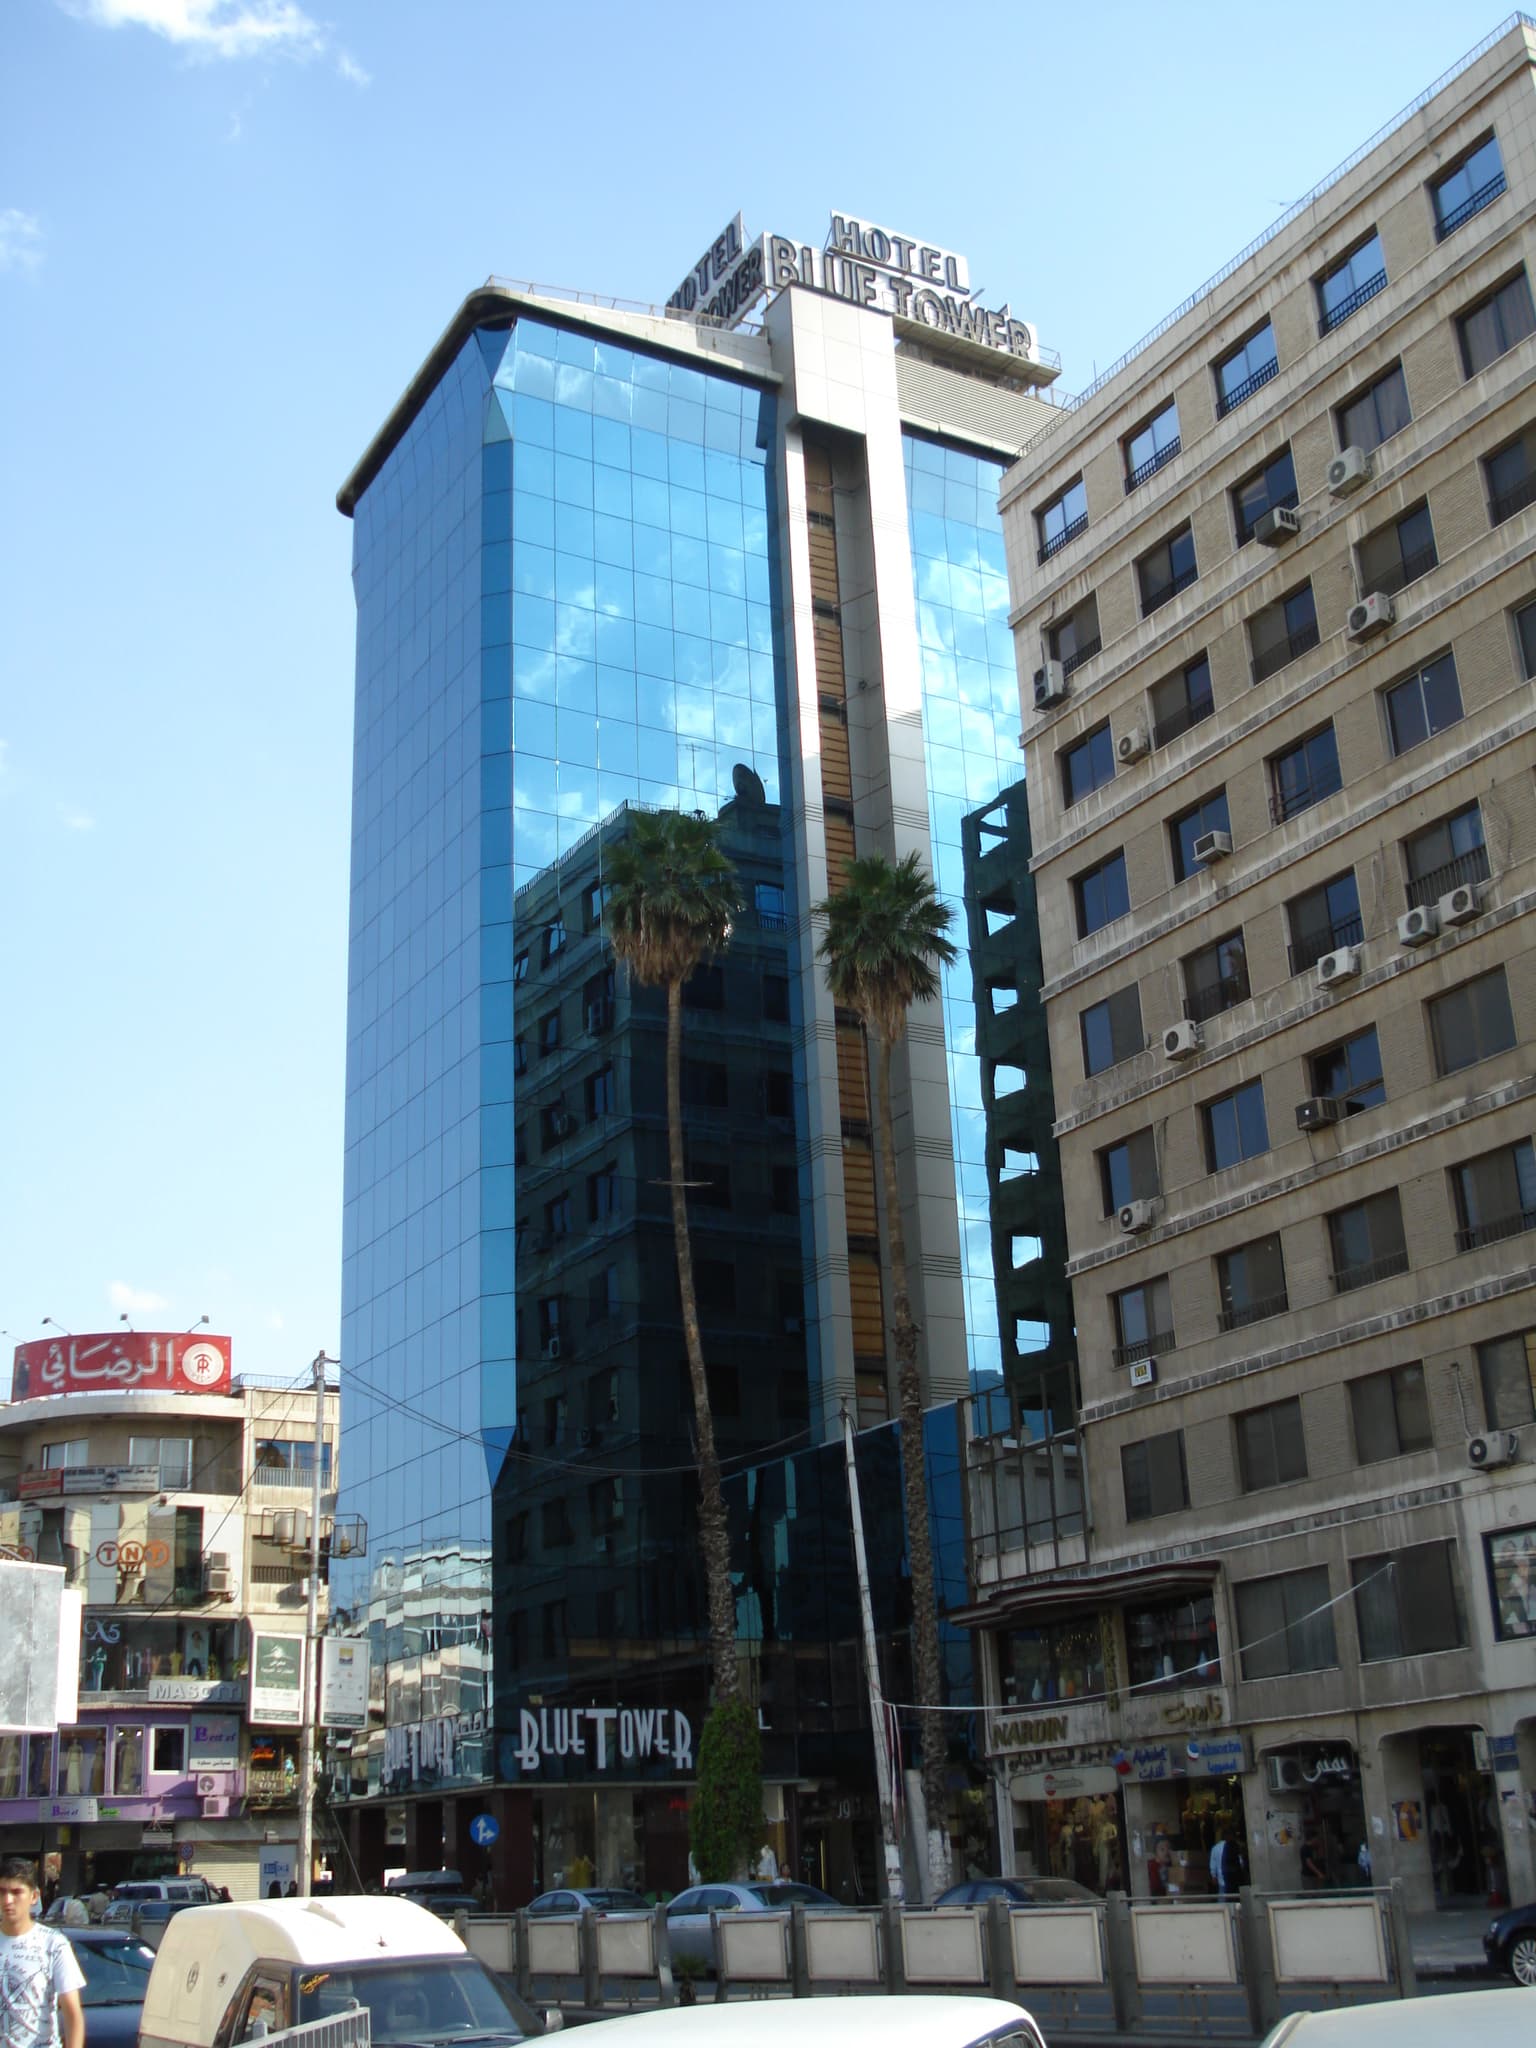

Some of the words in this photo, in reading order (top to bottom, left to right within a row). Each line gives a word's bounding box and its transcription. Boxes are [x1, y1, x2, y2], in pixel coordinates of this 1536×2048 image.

[832, 215, 970, 295] HOTEL
[772, 236, 877, 306] BLUE
[890, 277, 1032, 360] TOWER
[99, 1544, 166, 1564] TNT
[991, 1716, 1069, 1749] NARDIN
